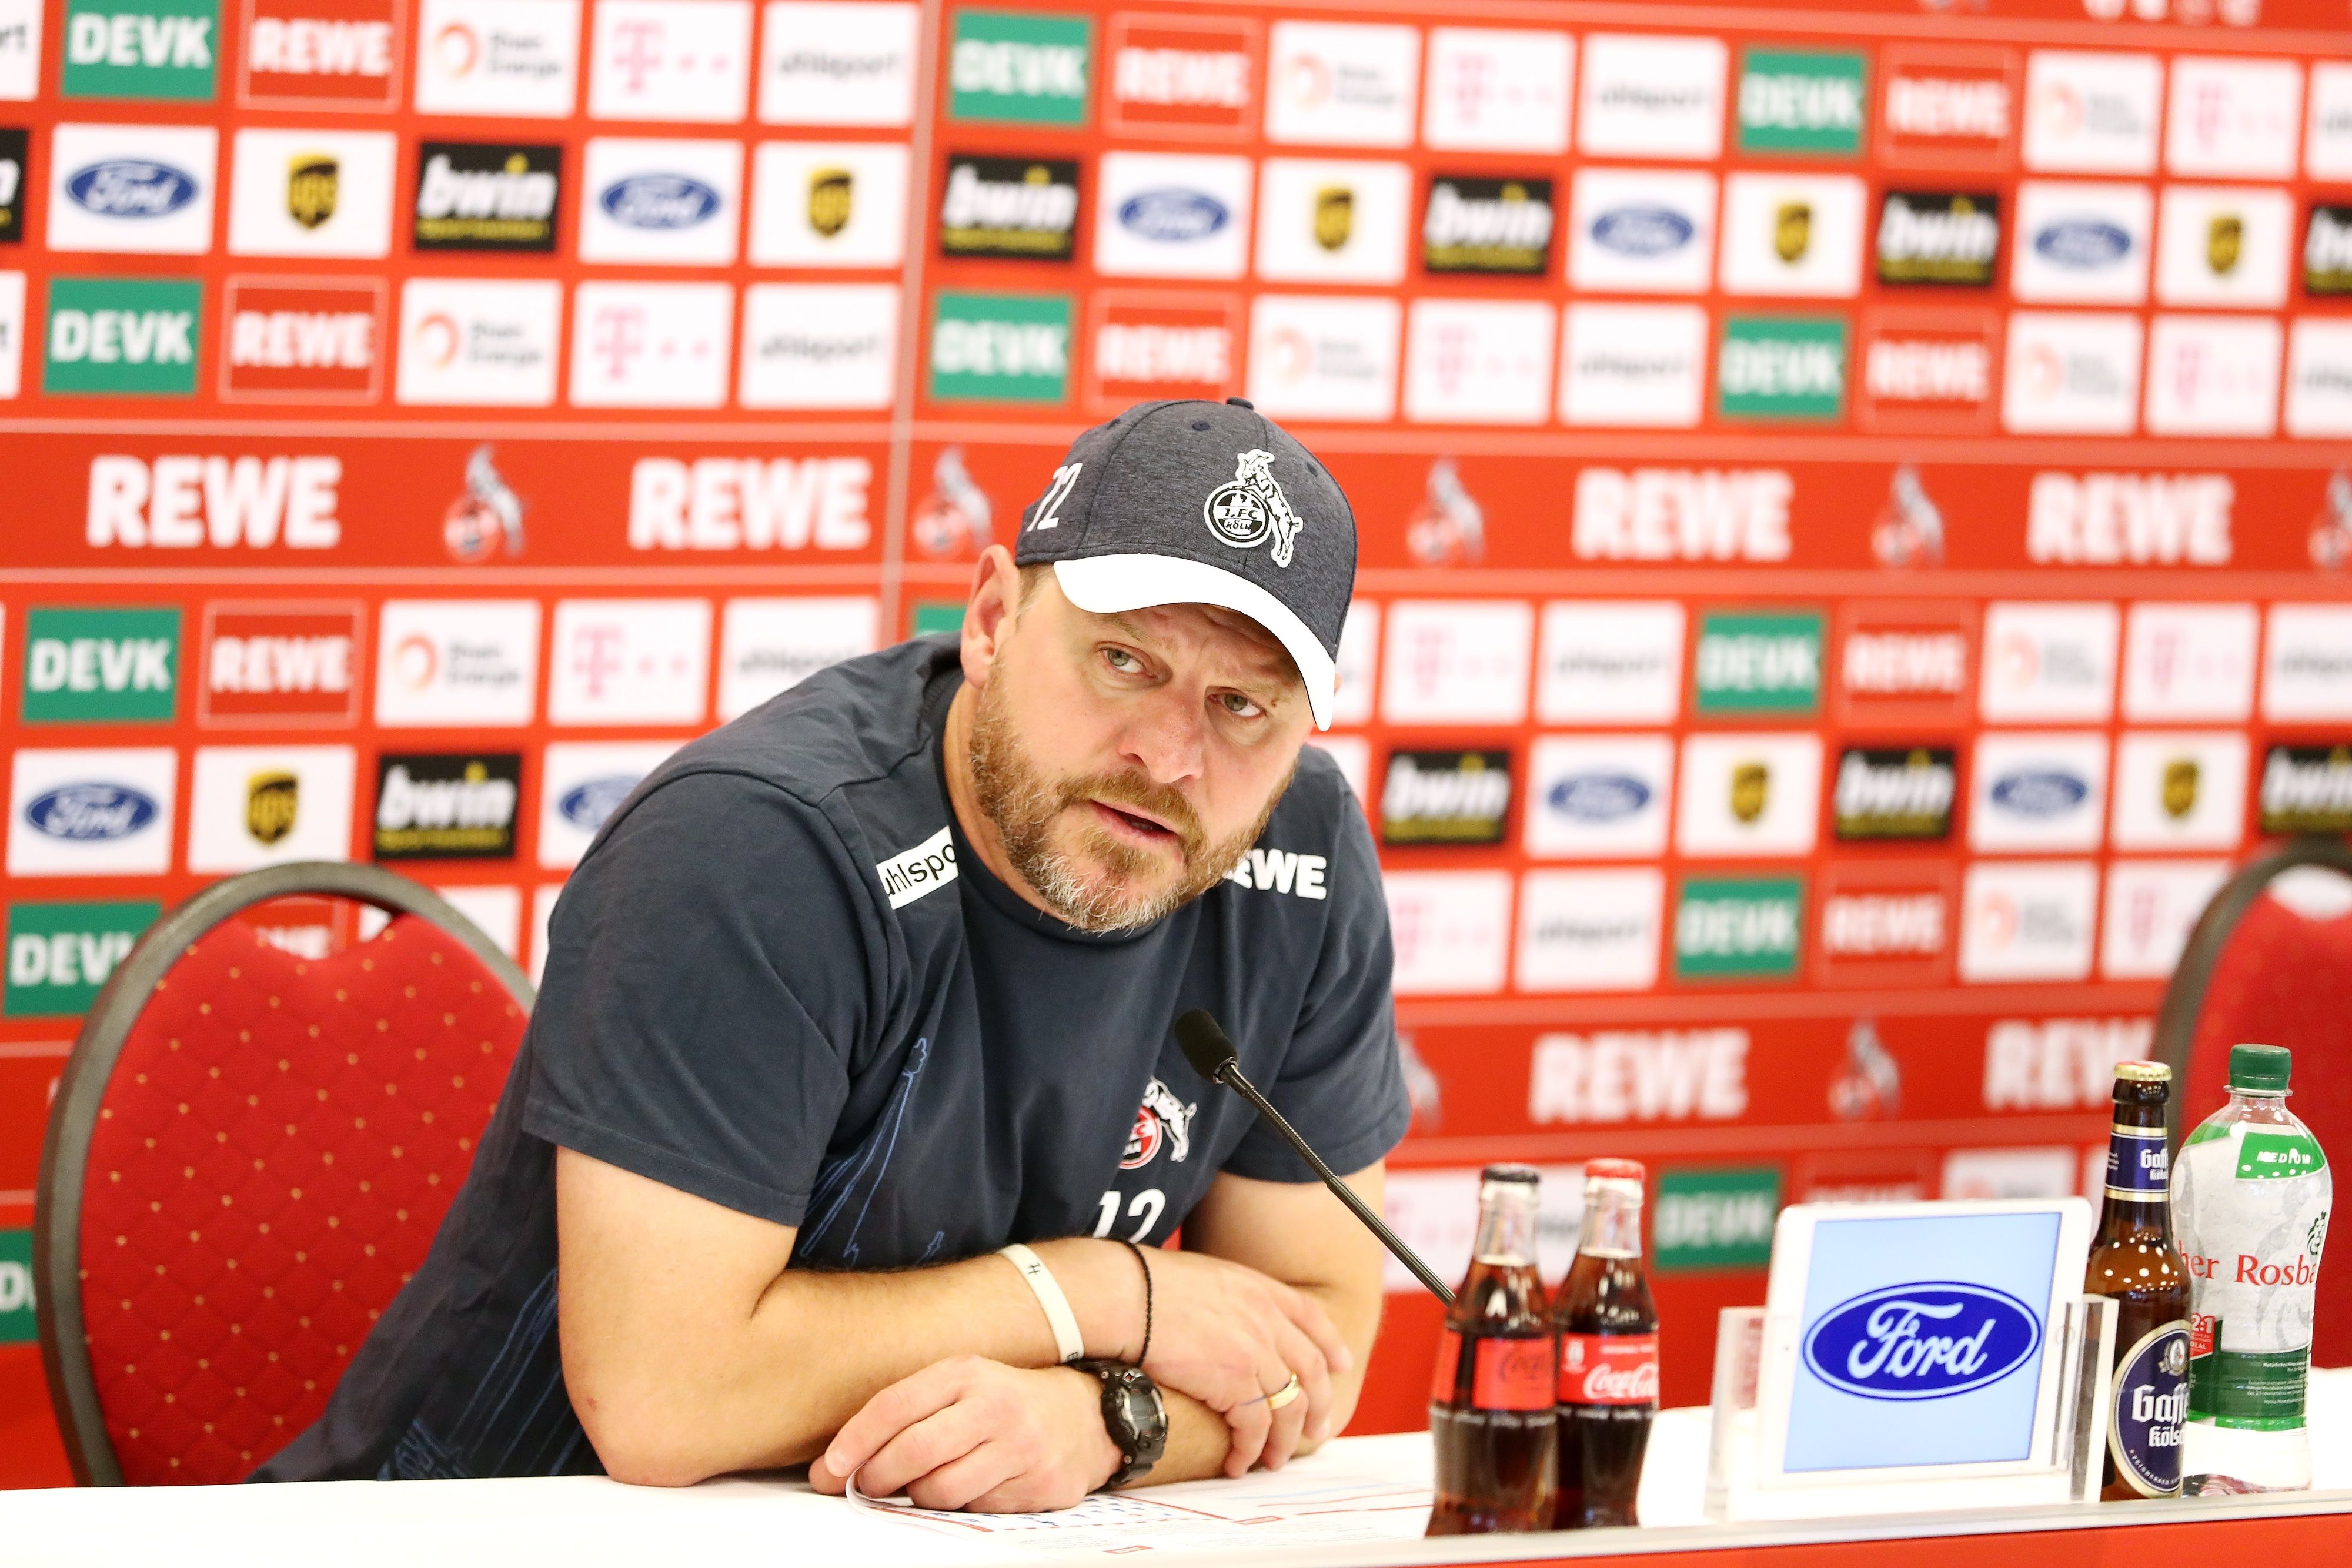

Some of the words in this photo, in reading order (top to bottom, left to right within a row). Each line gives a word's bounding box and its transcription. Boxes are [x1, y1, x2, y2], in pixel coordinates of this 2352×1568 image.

[68, 13, 211, 68] DEVK
[247, 18, 394, 76] REWE
[951, 39, 1087, 97] DEVK
[1114, 48, 1251, 106] REWE
[1738, 73, 1863, 130] DEVK
[1885, 78, 2010, 136] REWE
[416, 154, 557, 219] bwin
[944, 165, 1078, 231] bwin
[1426, 183, 1552, 249] bwin
[50, 310, 192, 363] DEVK
[229, 312, 375, 367] REWE
[931, 320, 1068, 376] DEVK
[1095, 325, 1232, 383] REWE
[1719, 339, 1842, 394] DEVK
[1866, 342, 1990, 400] REWE
[87, 456, 342, 547] REWE
[629, 459, 870, 549] REWE
[1237, 509, 1258, 520] FC
[1573, 469, 1792, 560] REWE
[2028, 474, 2233, 563] REWE
[29, 639, 171, 691] DEVK
[209, 637, 353, 691] REWE
[1697, 635, 1819, 690] DEVK
[1843, 634, 1966, 691] REWE
[376, 764, 516, 829] bwin
[1384, 755, 1509, 822] bwin
[1676, 900, 1798, 955] DEVK
[1822, 897, 1944, 951] REWE
[11, 934, 131, 986] DEV
[1530, 1030, 1748, 1122] REWE
[1847, 1299, 1996, 1379] Ford
